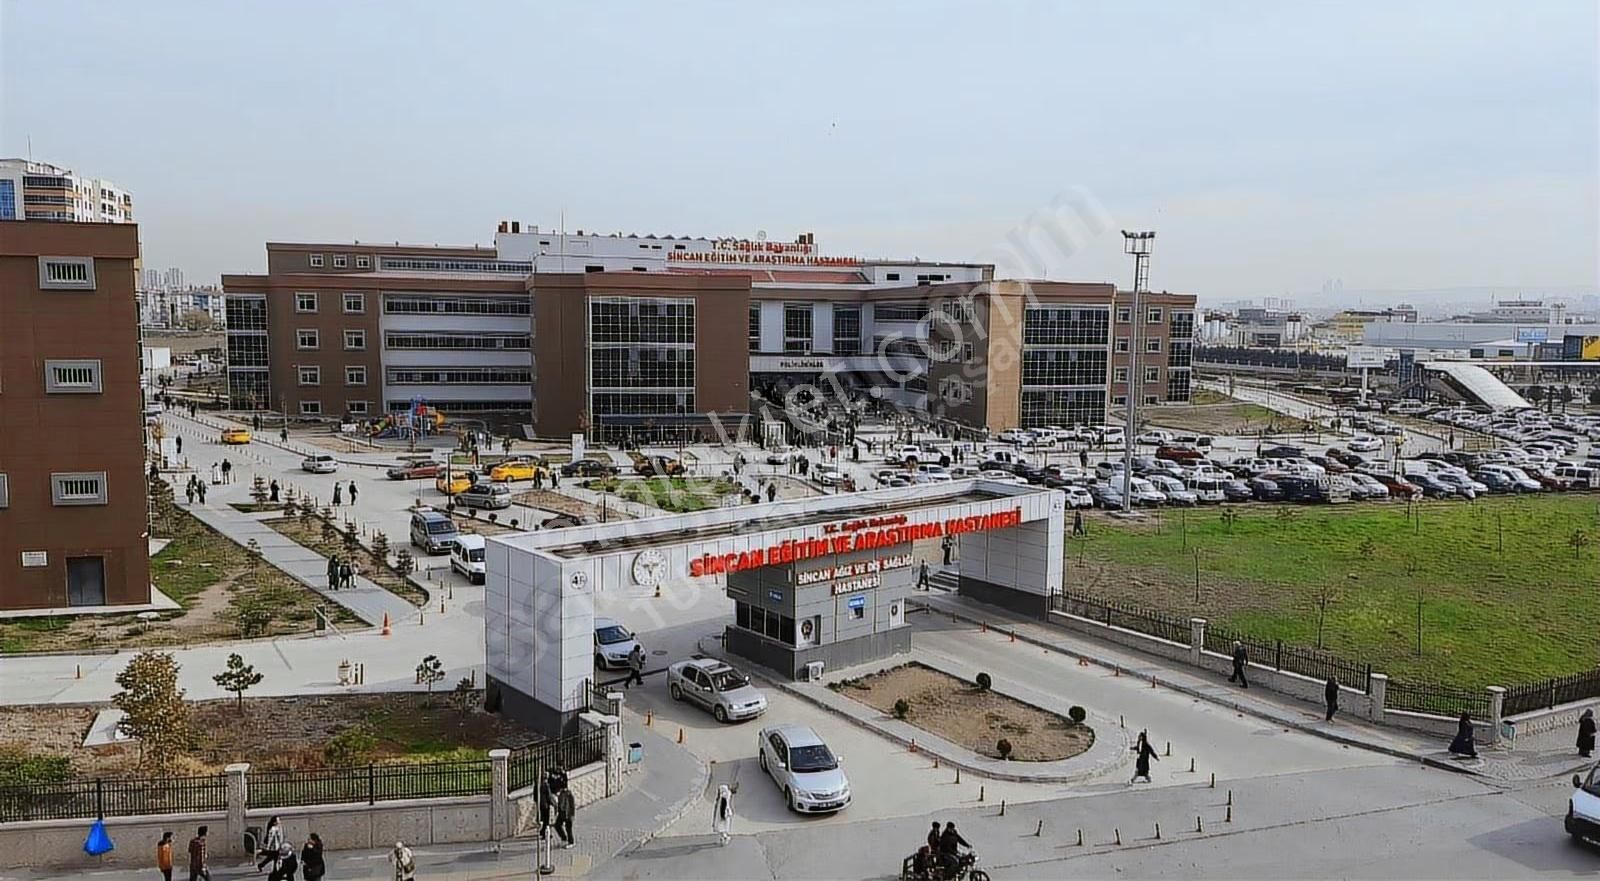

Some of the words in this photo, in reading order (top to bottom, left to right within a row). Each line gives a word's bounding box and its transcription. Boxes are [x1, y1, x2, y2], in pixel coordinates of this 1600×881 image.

[733, 240, 763, 253] Sağlık
[766, 241, 812, 255] Bakanlığı
[667, 251, 702, 262] SİNCAN
[704, 251, 737, 263] EĞİTİM
[738, 254, 750, 263] VE
[752, 254, 805, 266] ARAŞTIRMA
[807, 255, 857, 267] HASTANESİ
[689, 548, 763, 577] SİNCAN
[768, 537, 829, 566] EĞİTİM
[831, 535, 851, 555] VE
[854, 521, 943, 551] ARAŞTIRMA
[945, 506, 1021, 536] HASTANESİ
[798, 568, 831, 585] SİNCAN
[855, 563, 866, 574] VE
[883, 554, 913, 569] SAĞLIĞI
[834, 574, 880, 595] HASTANESİ
